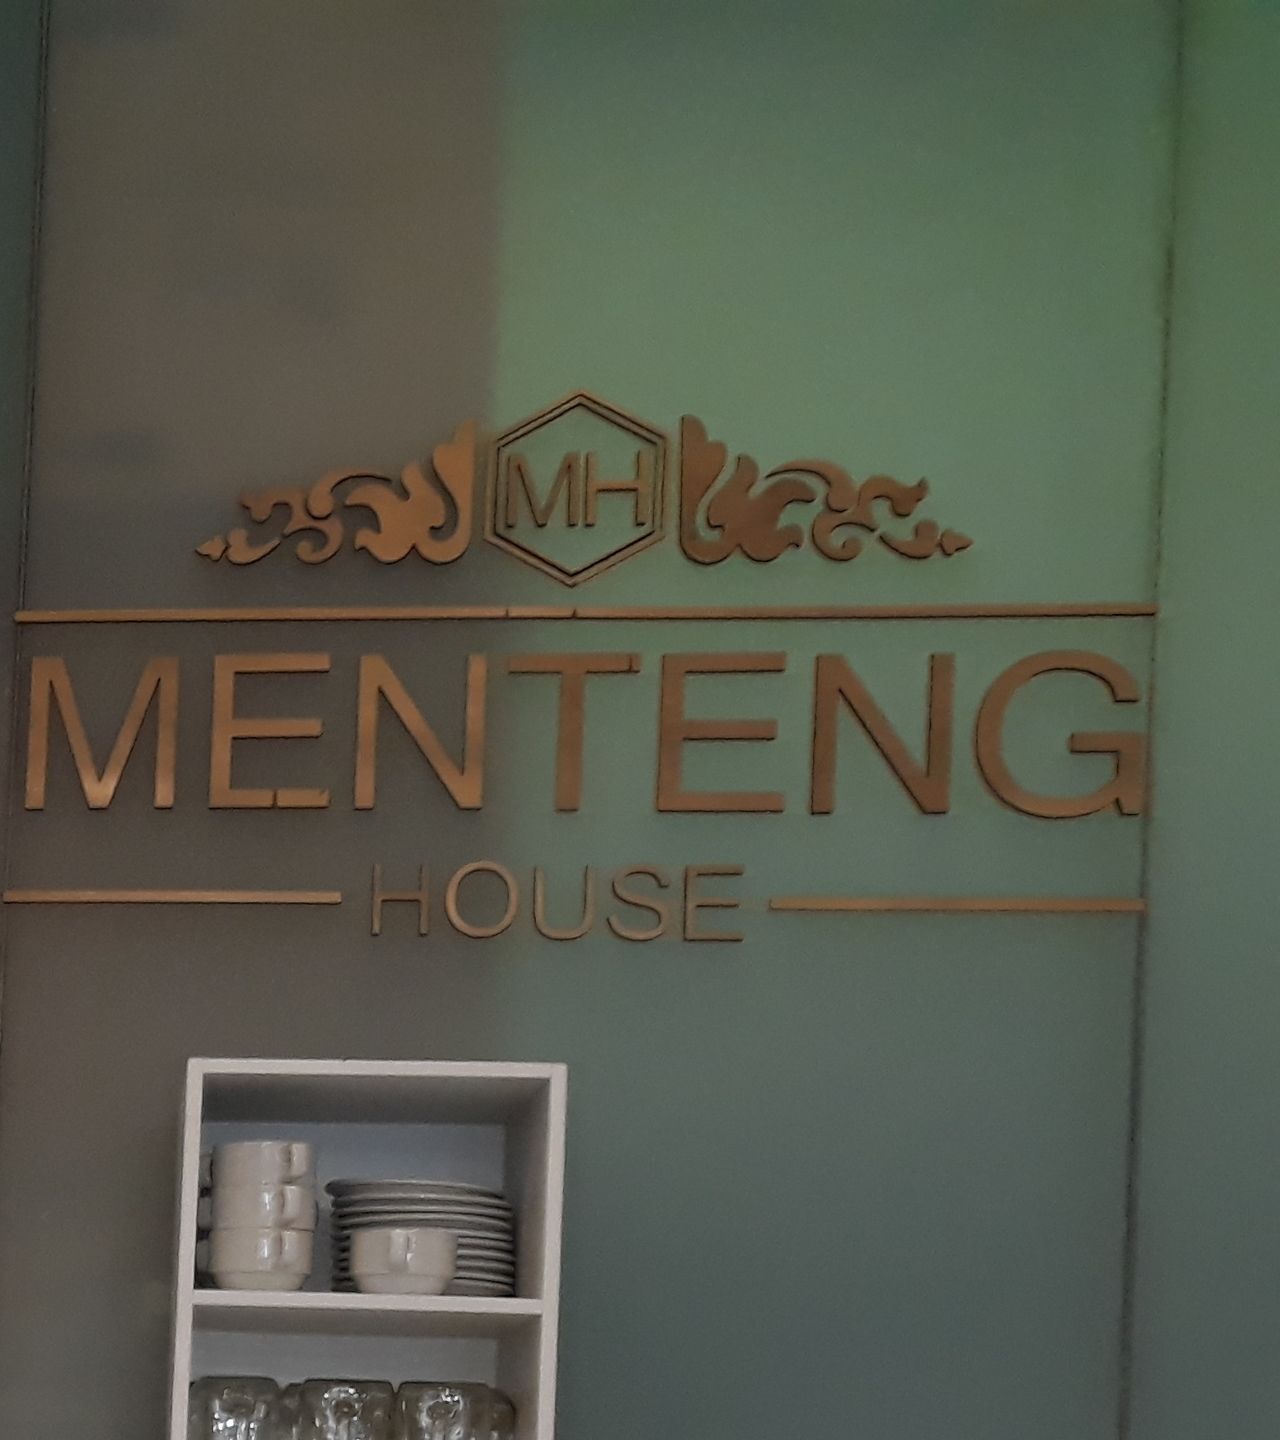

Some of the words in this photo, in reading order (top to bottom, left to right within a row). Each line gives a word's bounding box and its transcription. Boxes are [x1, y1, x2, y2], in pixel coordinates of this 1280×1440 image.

[505, 451, 648, 528] MH
[25, 649, 1148, 819] MENTENG
[371, 860, 746, 942] HOUSE
